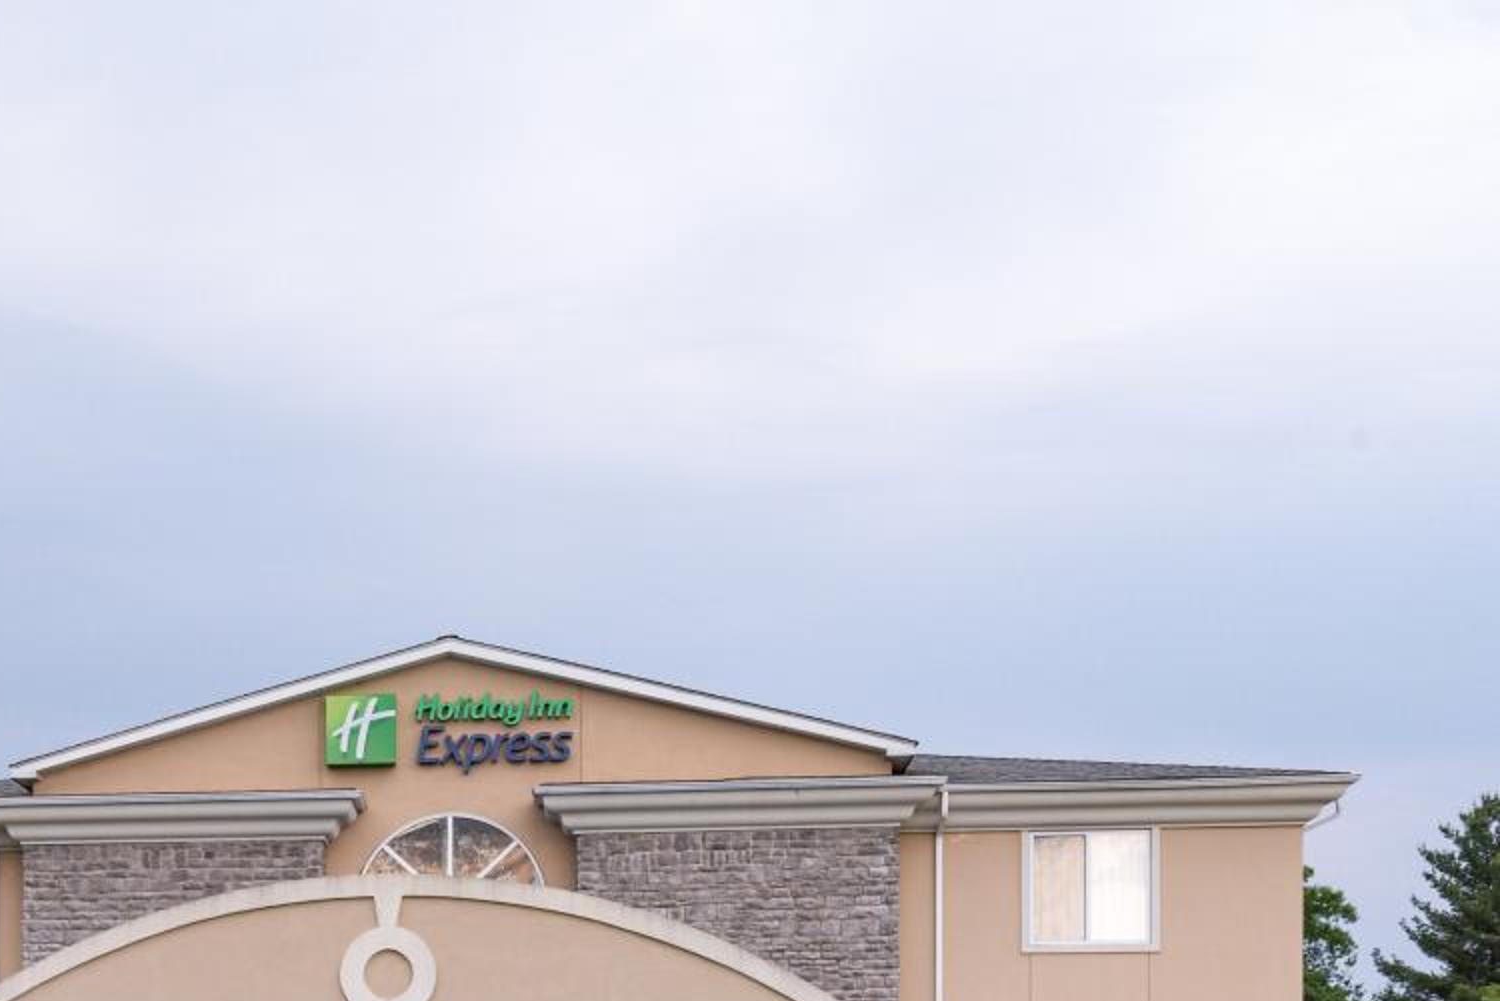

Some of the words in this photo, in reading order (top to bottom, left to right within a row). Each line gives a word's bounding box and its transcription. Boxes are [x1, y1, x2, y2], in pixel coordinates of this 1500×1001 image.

[416, 692, 524, 726] Holiday
[528, 689, 573, 720] Inn
[417, 725, 573, 775] Express
